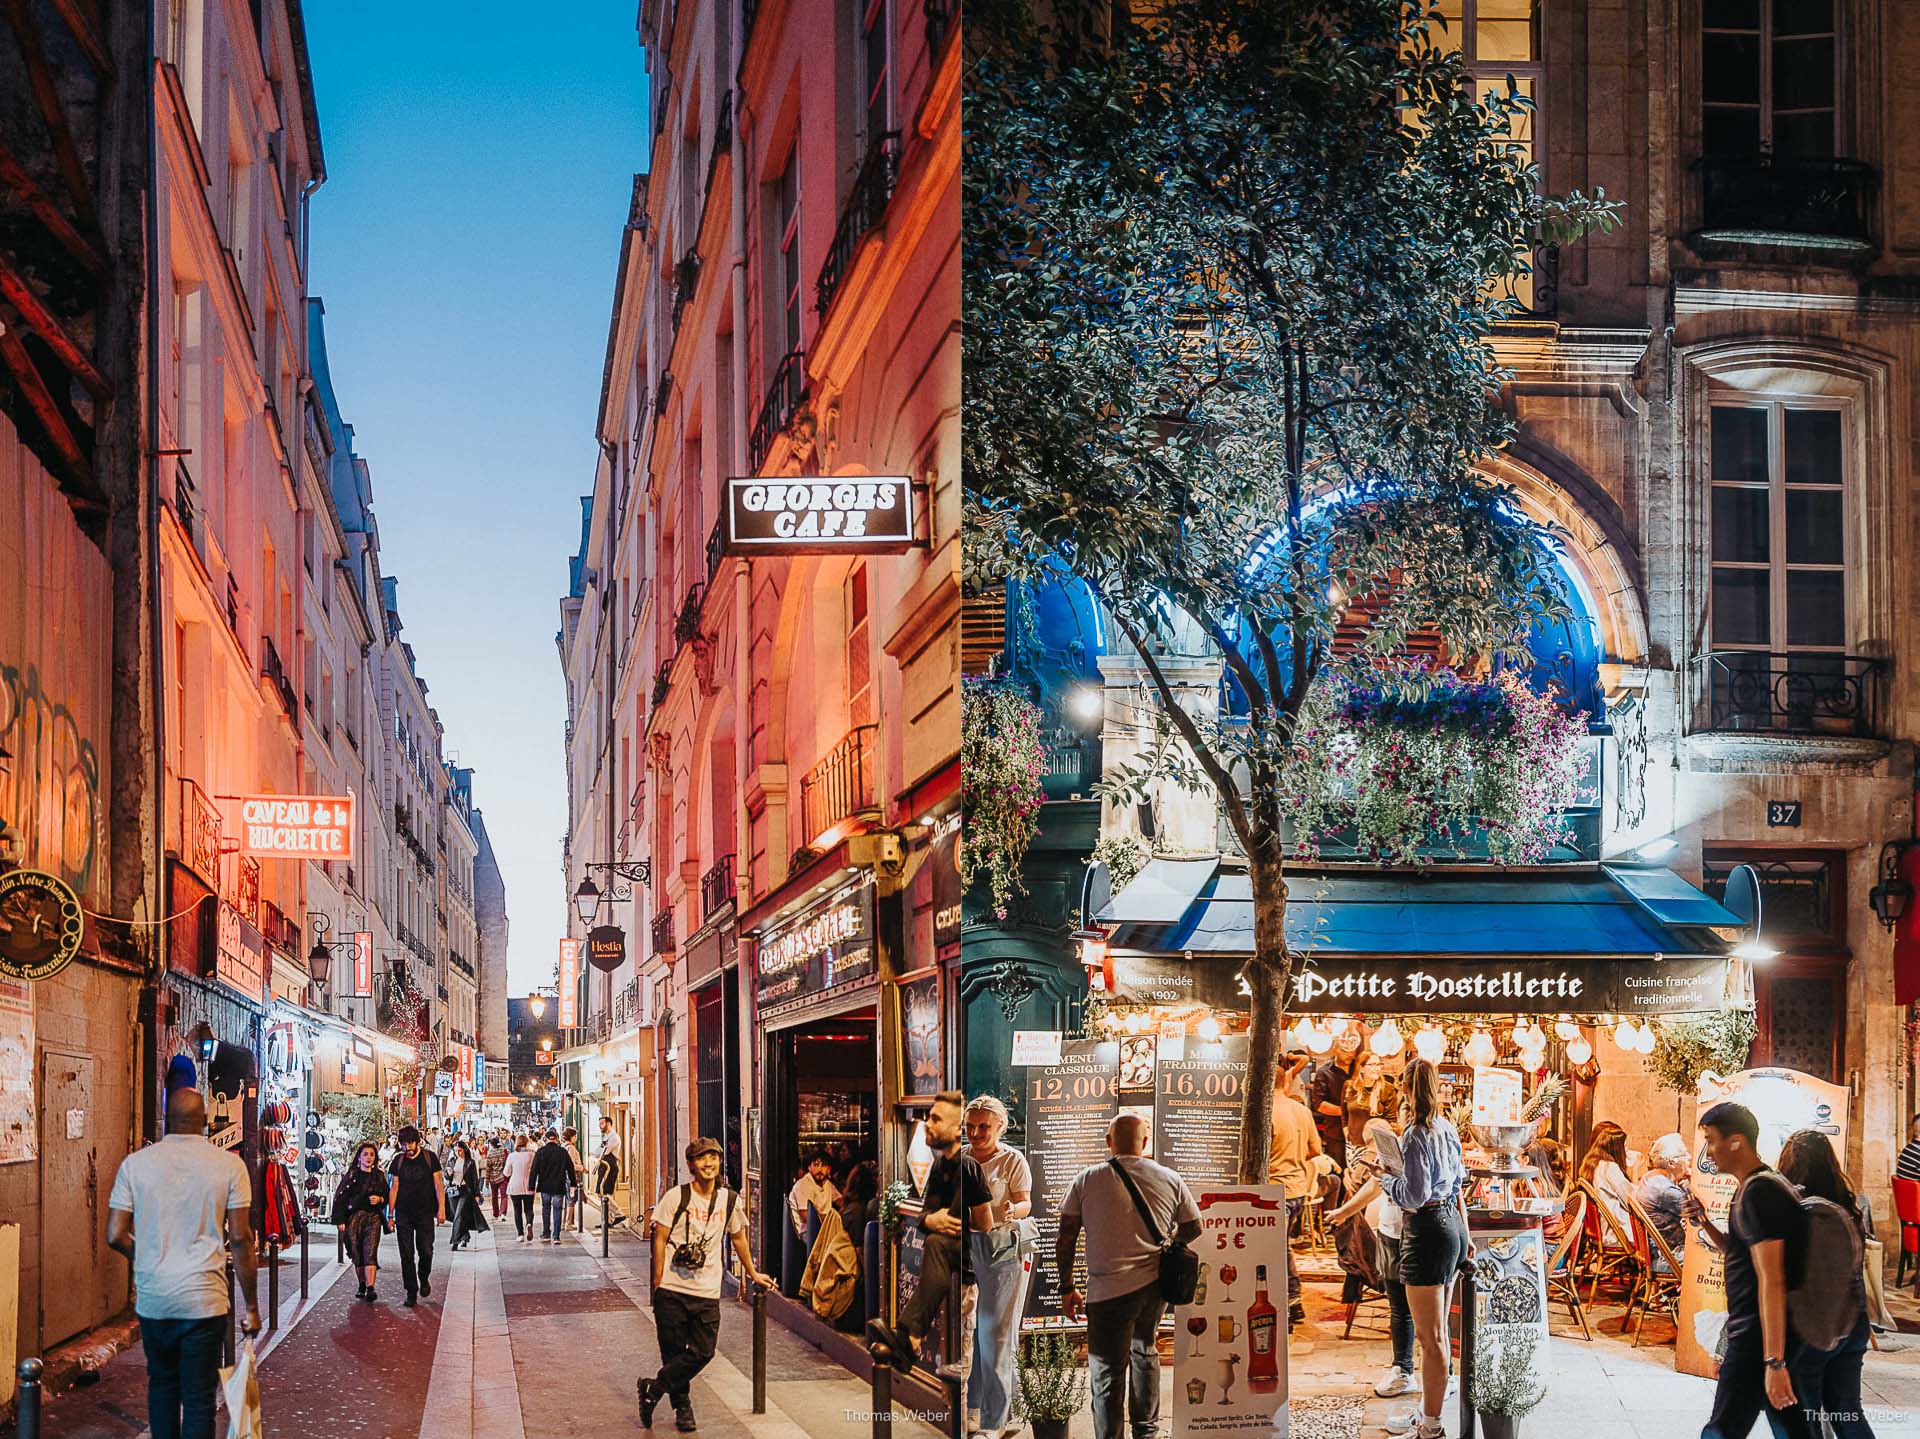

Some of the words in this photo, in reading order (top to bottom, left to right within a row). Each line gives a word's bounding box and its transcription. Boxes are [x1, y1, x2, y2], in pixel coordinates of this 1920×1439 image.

[742, 484, 896, 511] GEORGES
[773, 511, 867, 537] CAFE
[243, 800, 309, 825] CAVEAU
[313, 803, 330, 826] de
[334, 805, 347, 826] la
[1772, 805, 1796, 823] 37
[248, 825, 342, 851] HUCHETTE
[17, 872, 44, 886] Notre
[44, 880, 68, 903] Dame
[591, 940, 622, 952] Hestia
[21, 949, 68, 979] Française
[1118, 975, 1155, 986] Maison
[1158, 975, 1193, 986] fondée
[1291, 970, 1397, 1003] Petite
[1405, 971, 1584, 1002] Hostellerie
[1625, 977, 1663, 988] Cuisine
[1665, 975, 1713, 988] française
[1138, 991, 1150, 999] en
[1151, 990, 1177, 1000] 1902
[1634, 991, 1703, 1005] traditionnelle
[1059, 1054, 1096, 1065] MENU
[1044, 1064, 1110, 1076] CLASSIQUE
[1031, 1076, 1118, 1103] 12,00€
[688, 1206, 725, 1223] Start
[1236, 1216, 1276, 1228] HOUR
[1216, 1233, 1228, 1250] 5
[1232, 1232, 1246, 1249] €
[1709, 1267, 1722, 1278] La
